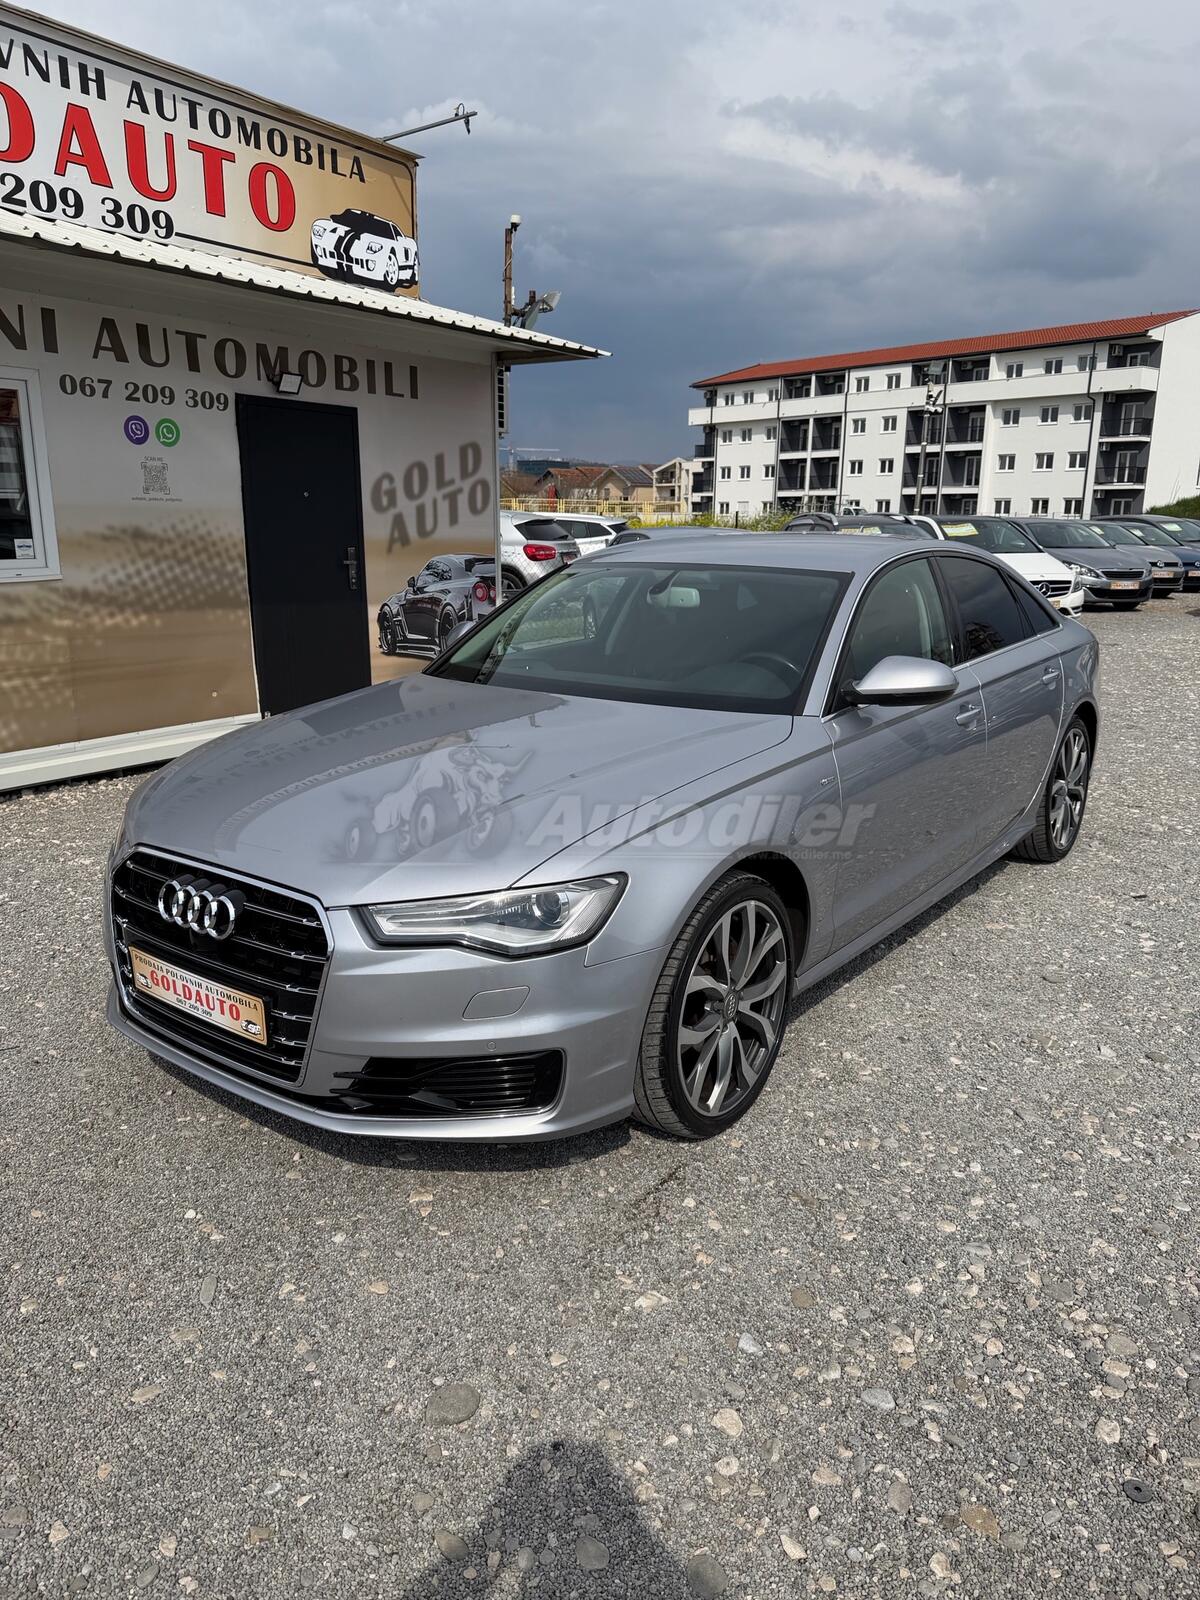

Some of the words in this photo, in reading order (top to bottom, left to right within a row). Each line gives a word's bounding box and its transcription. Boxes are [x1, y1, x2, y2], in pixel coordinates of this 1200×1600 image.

[126, 80, 366, 184] AUTOMOBILA
[0, 172, 84, 219] 209
[101, 196, 175, 239] 309
[59, 374, 113, 399] 067
[124, 381, 176, 405] 209
[185, 388, 229, 411] 309
[93, 316, 419, 400] AUTOMOBILI
[370, 441, 482, 515] GOLD
[386, 477, 491, 556] AUTO
[134, 953, 164, 974] PRODAJA
[165, 968, 203, 990] POLOVNIH
[205, 984, 259, 1012] AUTOMOBILA
[150, 969, 241, 1022] GOLDAUTO
